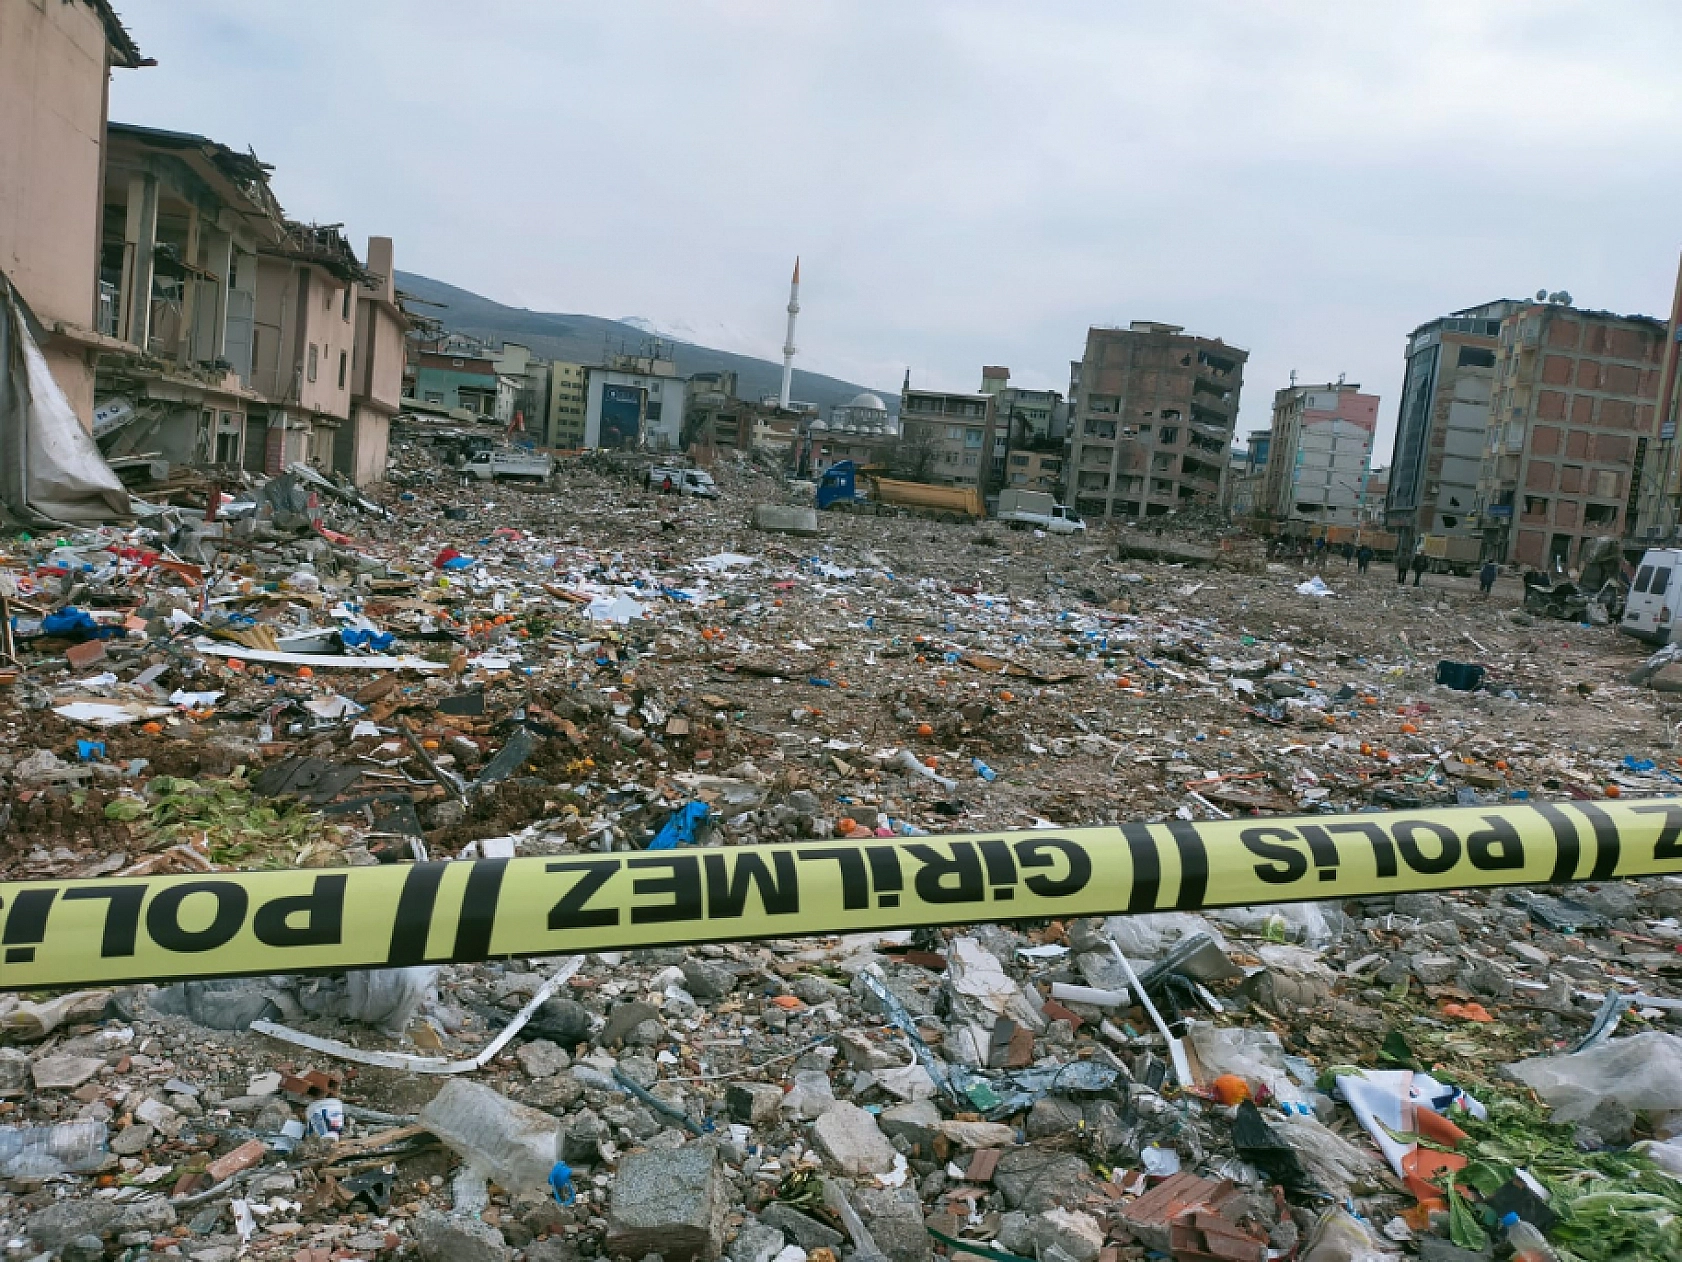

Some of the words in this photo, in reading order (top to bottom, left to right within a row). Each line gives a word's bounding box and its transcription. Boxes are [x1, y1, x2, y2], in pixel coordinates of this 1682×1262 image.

[545, 838, 1092, 931] GİRİLMEZ
[1240, 815, 1524, 884] POLİS
[0, 874, 348, 963] POLİ
